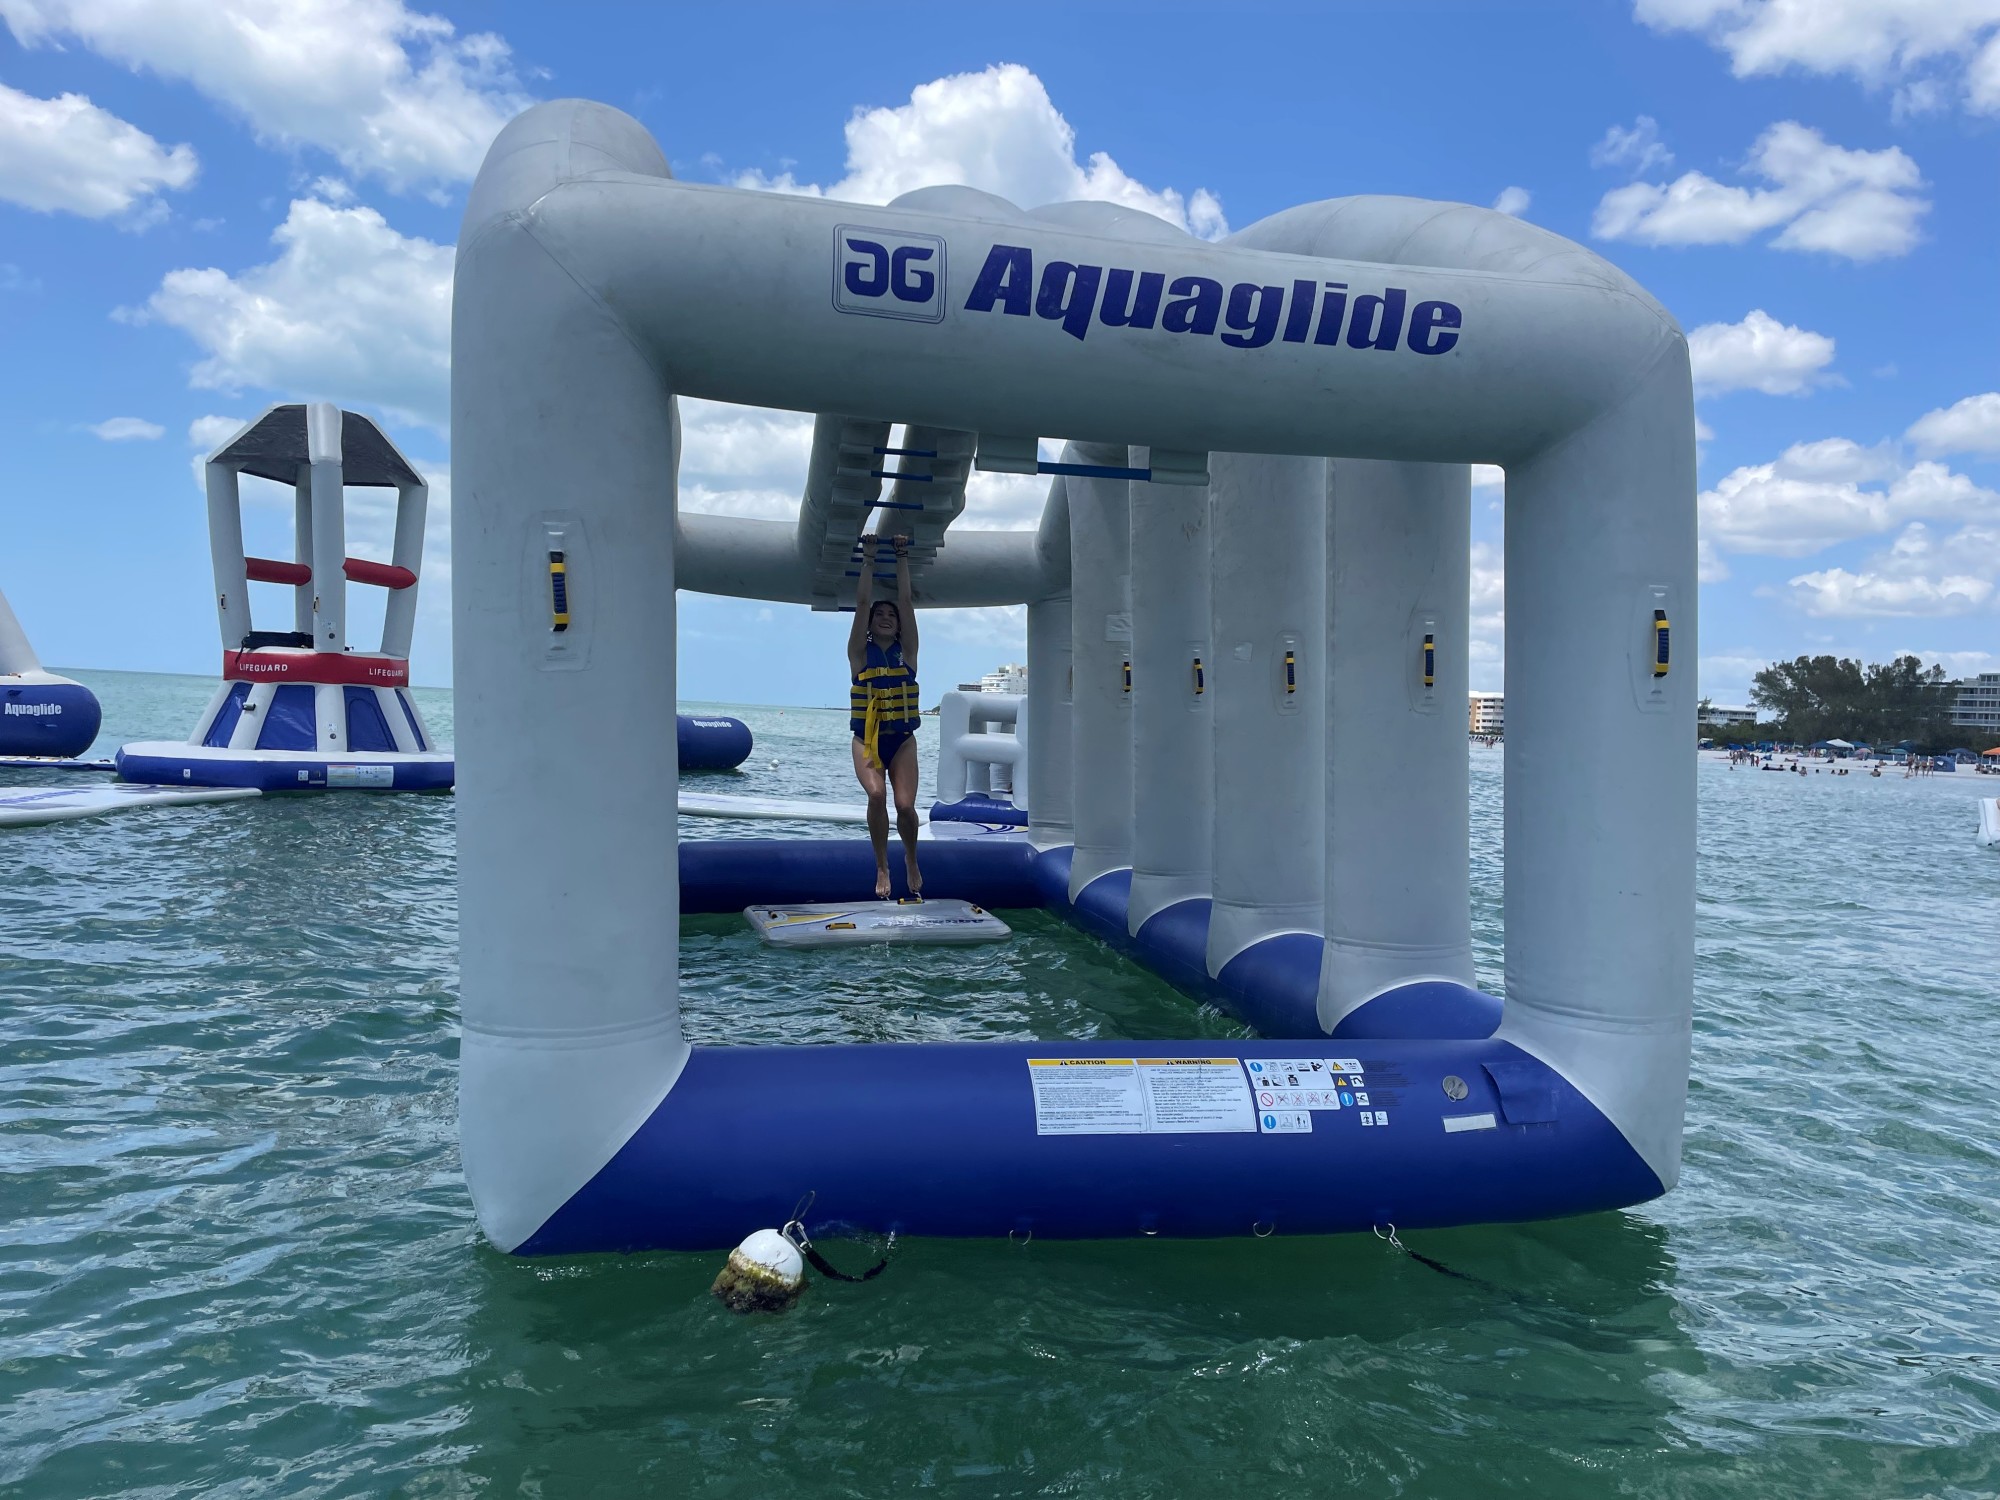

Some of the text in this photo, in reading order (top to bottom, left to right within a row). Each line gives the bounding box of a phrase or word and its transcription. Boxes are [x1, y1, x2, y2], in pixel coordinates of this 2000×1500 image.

[964, 243, 1463, 356] Aquaglide
[239, 663, 289, 673] LIFEGUARD
[369, 667, 404, 677] LIFEGUARD
[4, 702, 62, 717] Aquaglide
